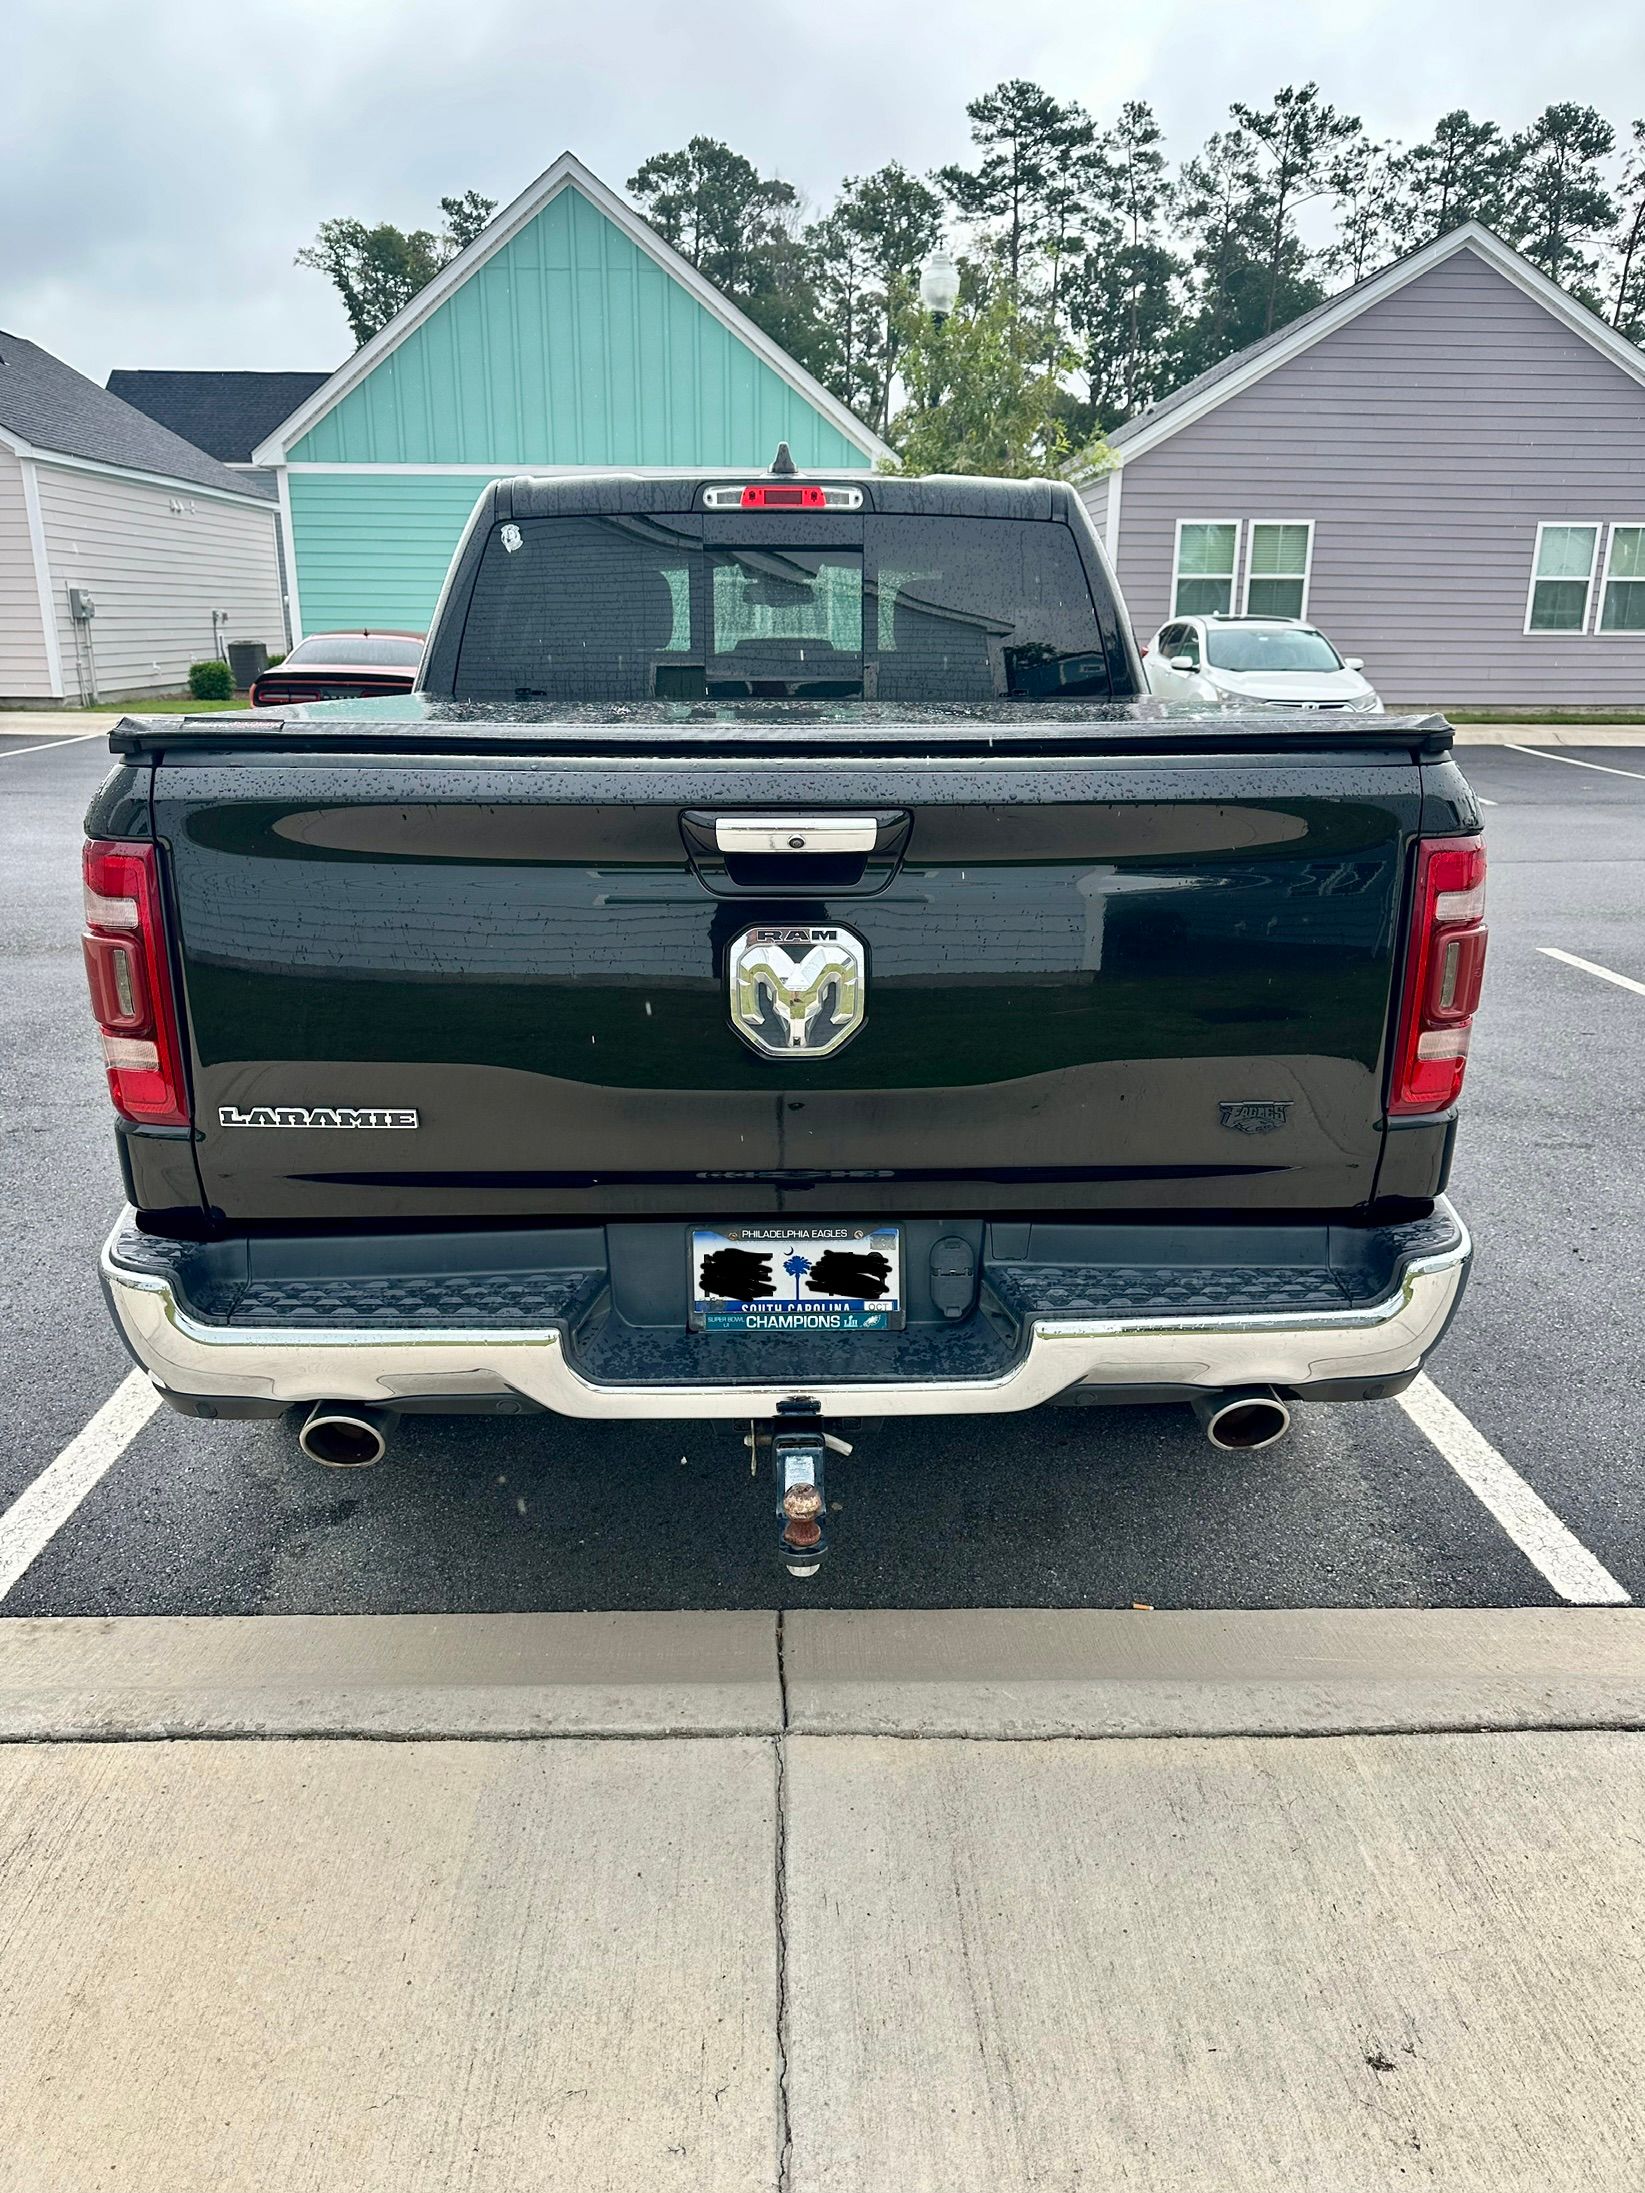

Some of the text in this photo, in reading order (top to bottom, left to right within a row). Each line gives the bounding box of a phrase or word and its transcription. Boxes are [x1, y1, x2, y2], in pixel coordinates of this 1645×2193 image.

[756, 929, 838, 942] RAM
[218, 1106, 420, 1129] LARAMIE
[741, 1228, 848, 1239] PHILADELPHIA EAGLES
[741, 1303, 850, 1311] SOUTH CAROLINA
[868, 1303, 888, 1311] OCT
[746, 1315, 841, 1328] CHAMPIONS
